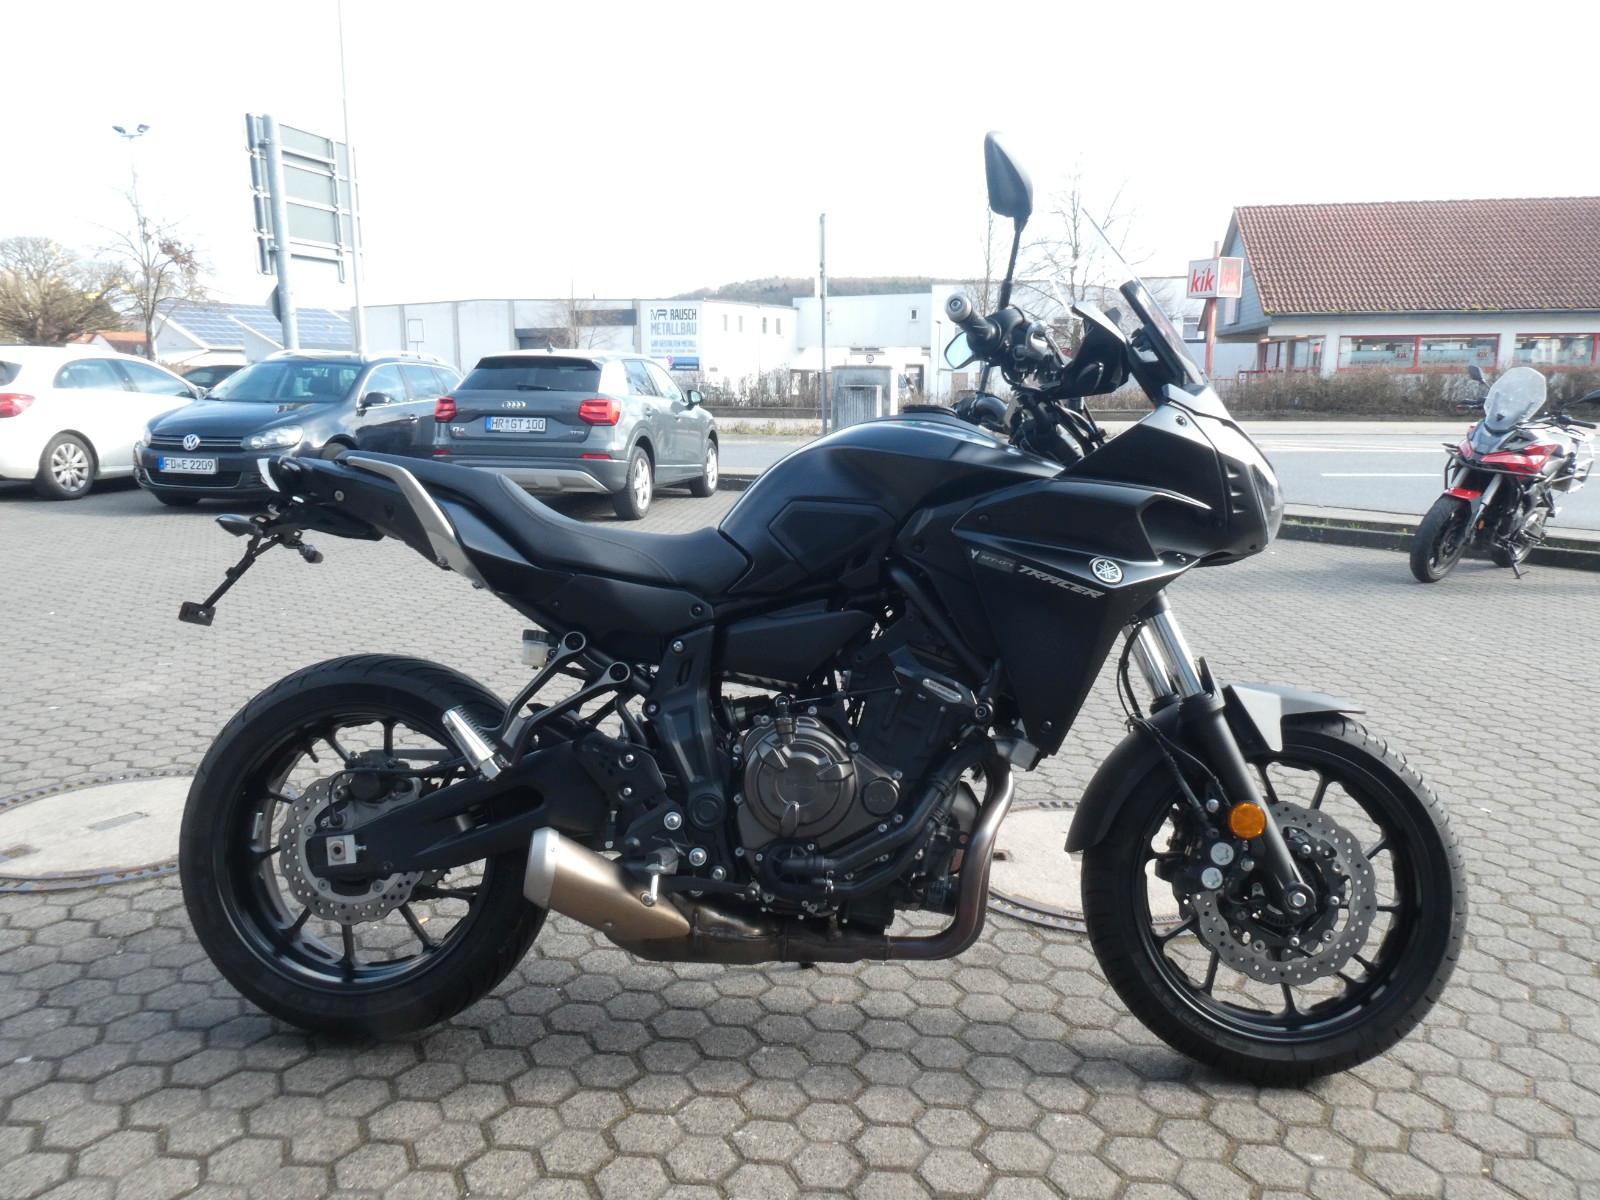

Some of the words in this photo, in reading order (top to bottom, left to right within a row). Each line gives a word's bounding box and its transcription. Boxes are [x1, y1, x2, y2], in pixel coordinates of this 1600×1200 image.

[1190, 268, 1215, 292] kik
[670, 308, 697, 320] RAUSCH
[650, 322, 697, 336] METALLBAU
[492, 417, 504, 429] HR
[511, 418, 523, 430] GT
[526, 418, 544, 430] 100
[165, 457, 177, 469] FD
[182, 460, 188, 470] E
[190, 460, 214, 471] 2209
[1018, 564, 1105, 598] TRACER
